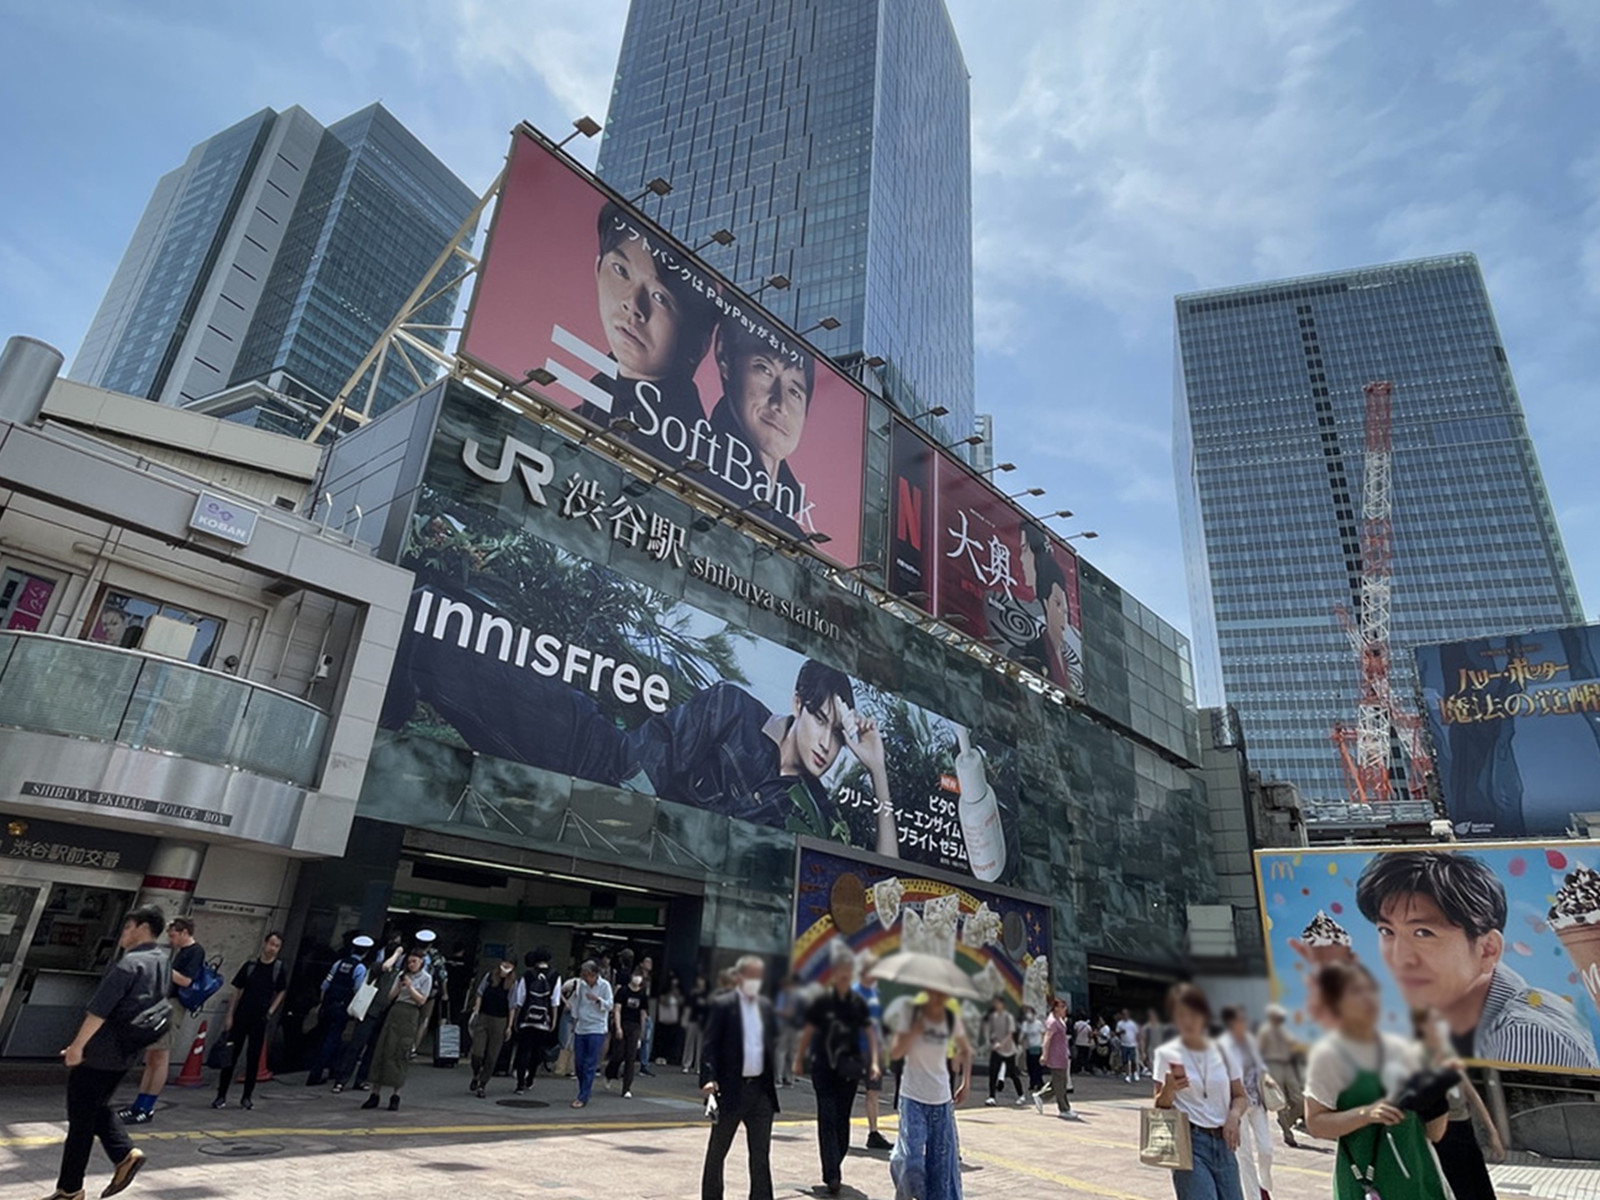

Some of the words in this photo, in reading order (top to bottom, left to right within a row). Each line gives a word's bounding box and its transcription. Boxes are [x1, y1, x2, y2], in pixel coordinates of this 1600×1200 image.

[629, 380, 816, 534] SoftBank
[198, 514, 247, 539] KOBAN
[462, 434, 556, 507] JR
[562, 472, 688, 569] 渋谷駅
[692, 554, 776, 609] shibuya
[779, 595, 841, 642] station
[896, 476, 922, 551] N
[31, 782, 147, 812] SHIBUYA-EKIMAE
[155, 802, 198, 821] POLICE
[203, 810, 227, 826] BOX
[9, 838, 121, 869] 渋谷駅前交番
